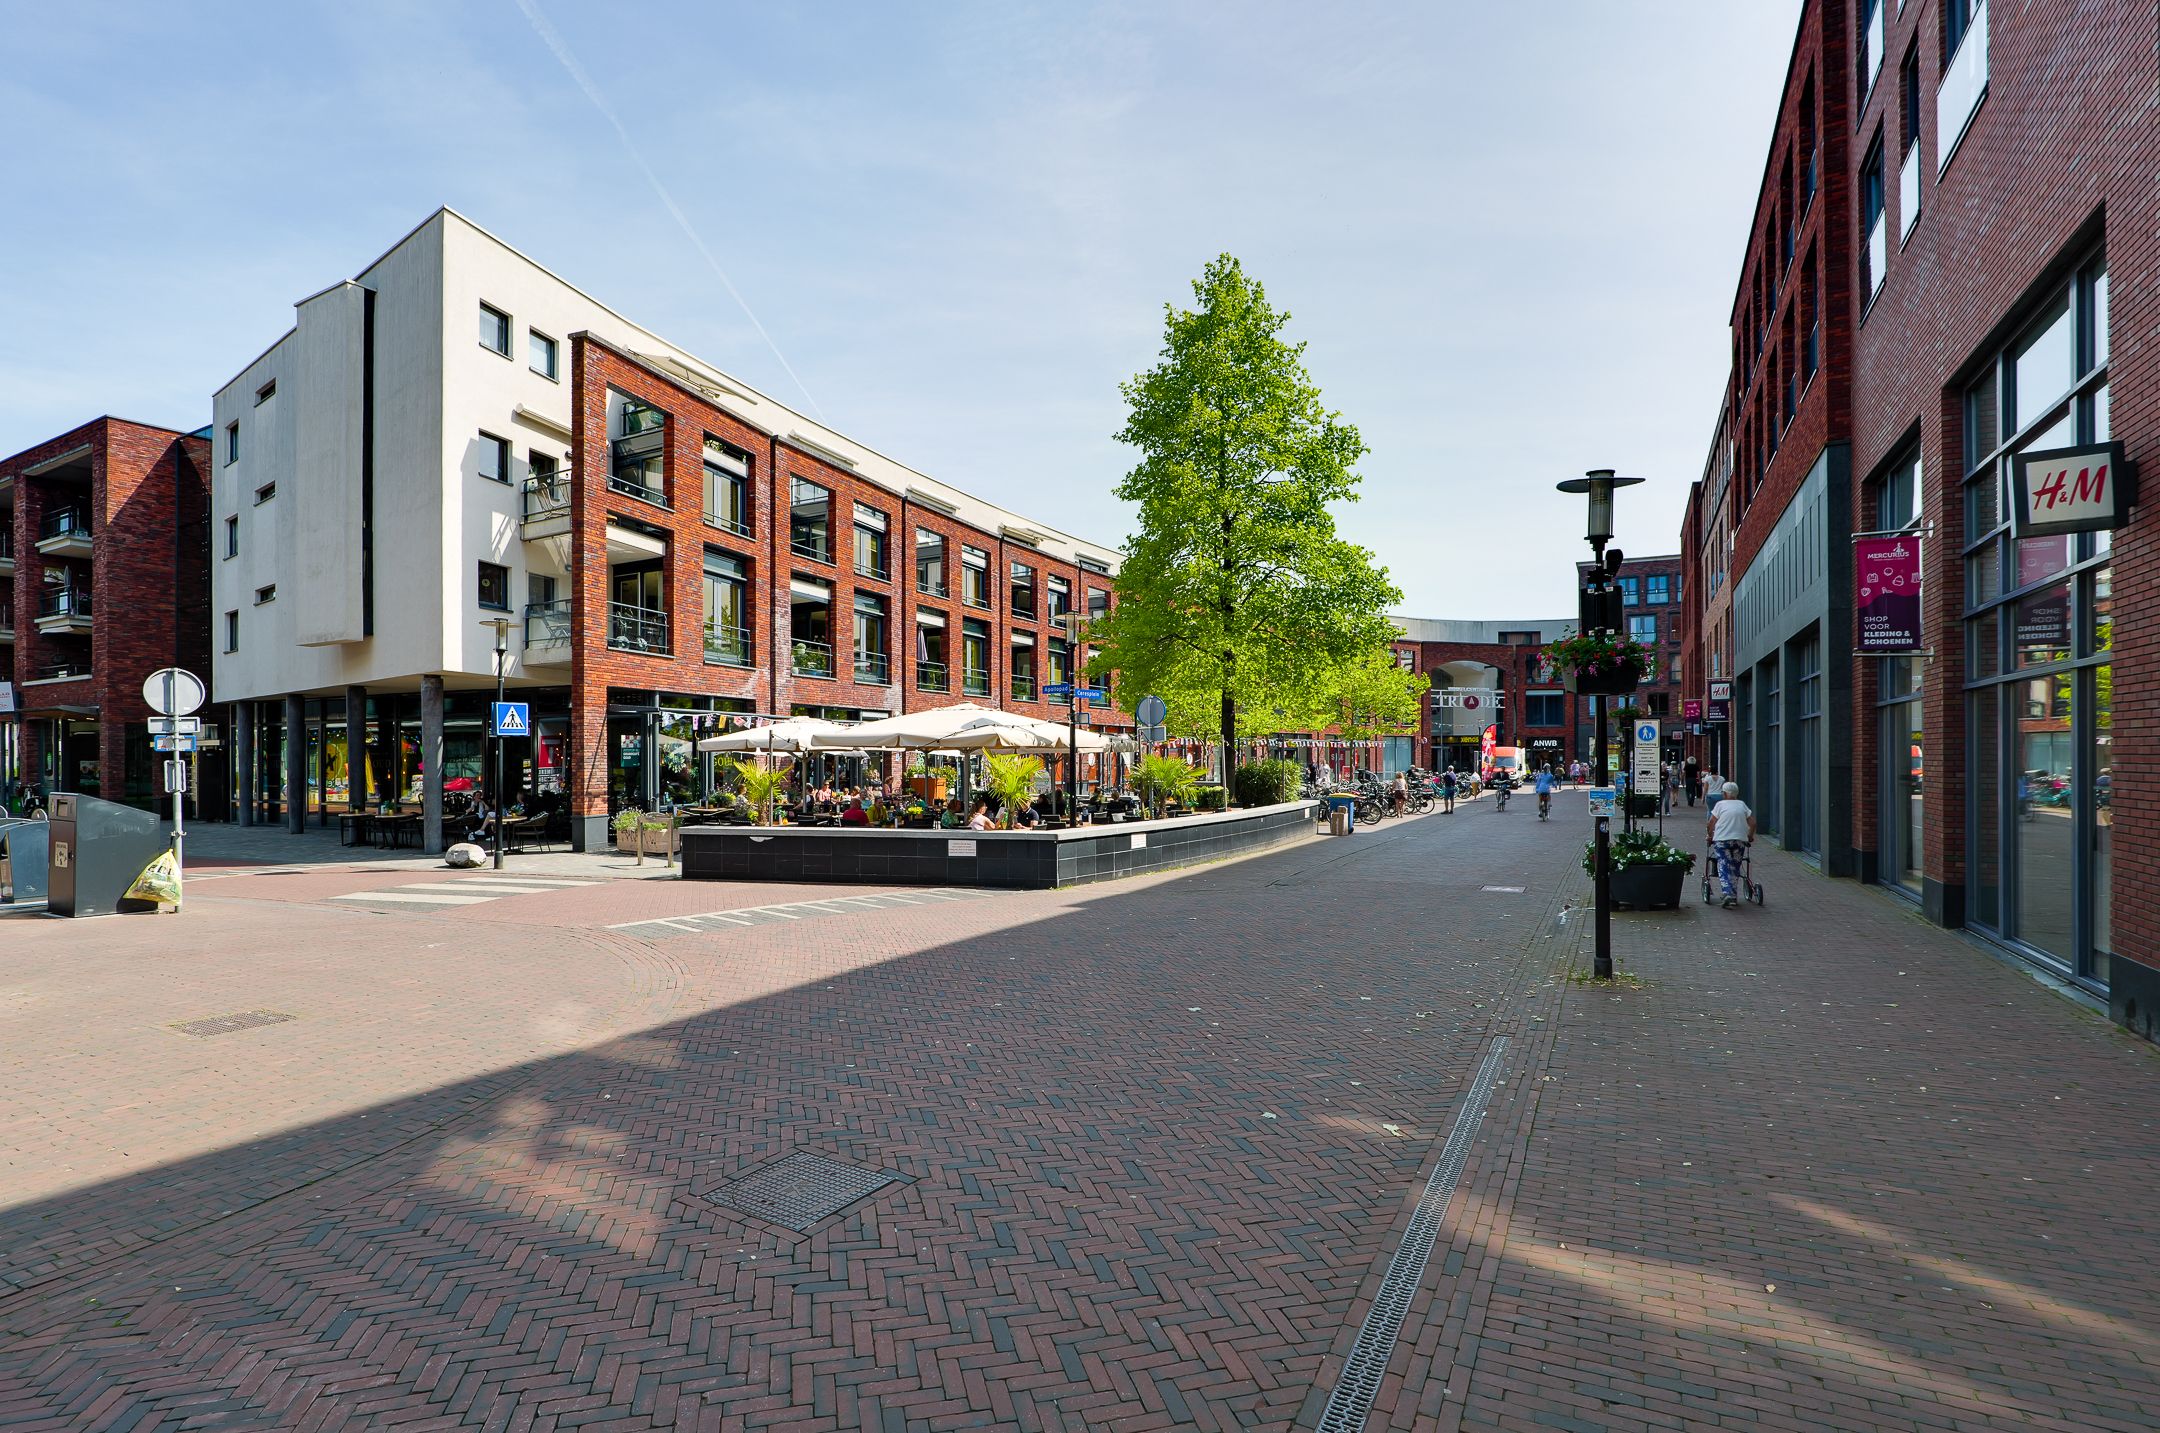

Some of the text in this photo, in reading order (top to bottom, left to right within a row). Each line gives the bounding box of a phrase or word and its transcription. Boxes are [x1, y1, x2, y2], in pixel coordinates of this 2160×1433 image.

[2032, 464, 2108, 510] H&M
[1867, 551, 1910, 559] MERCURIUS
[1713, 687, 1729, 697] H&M
